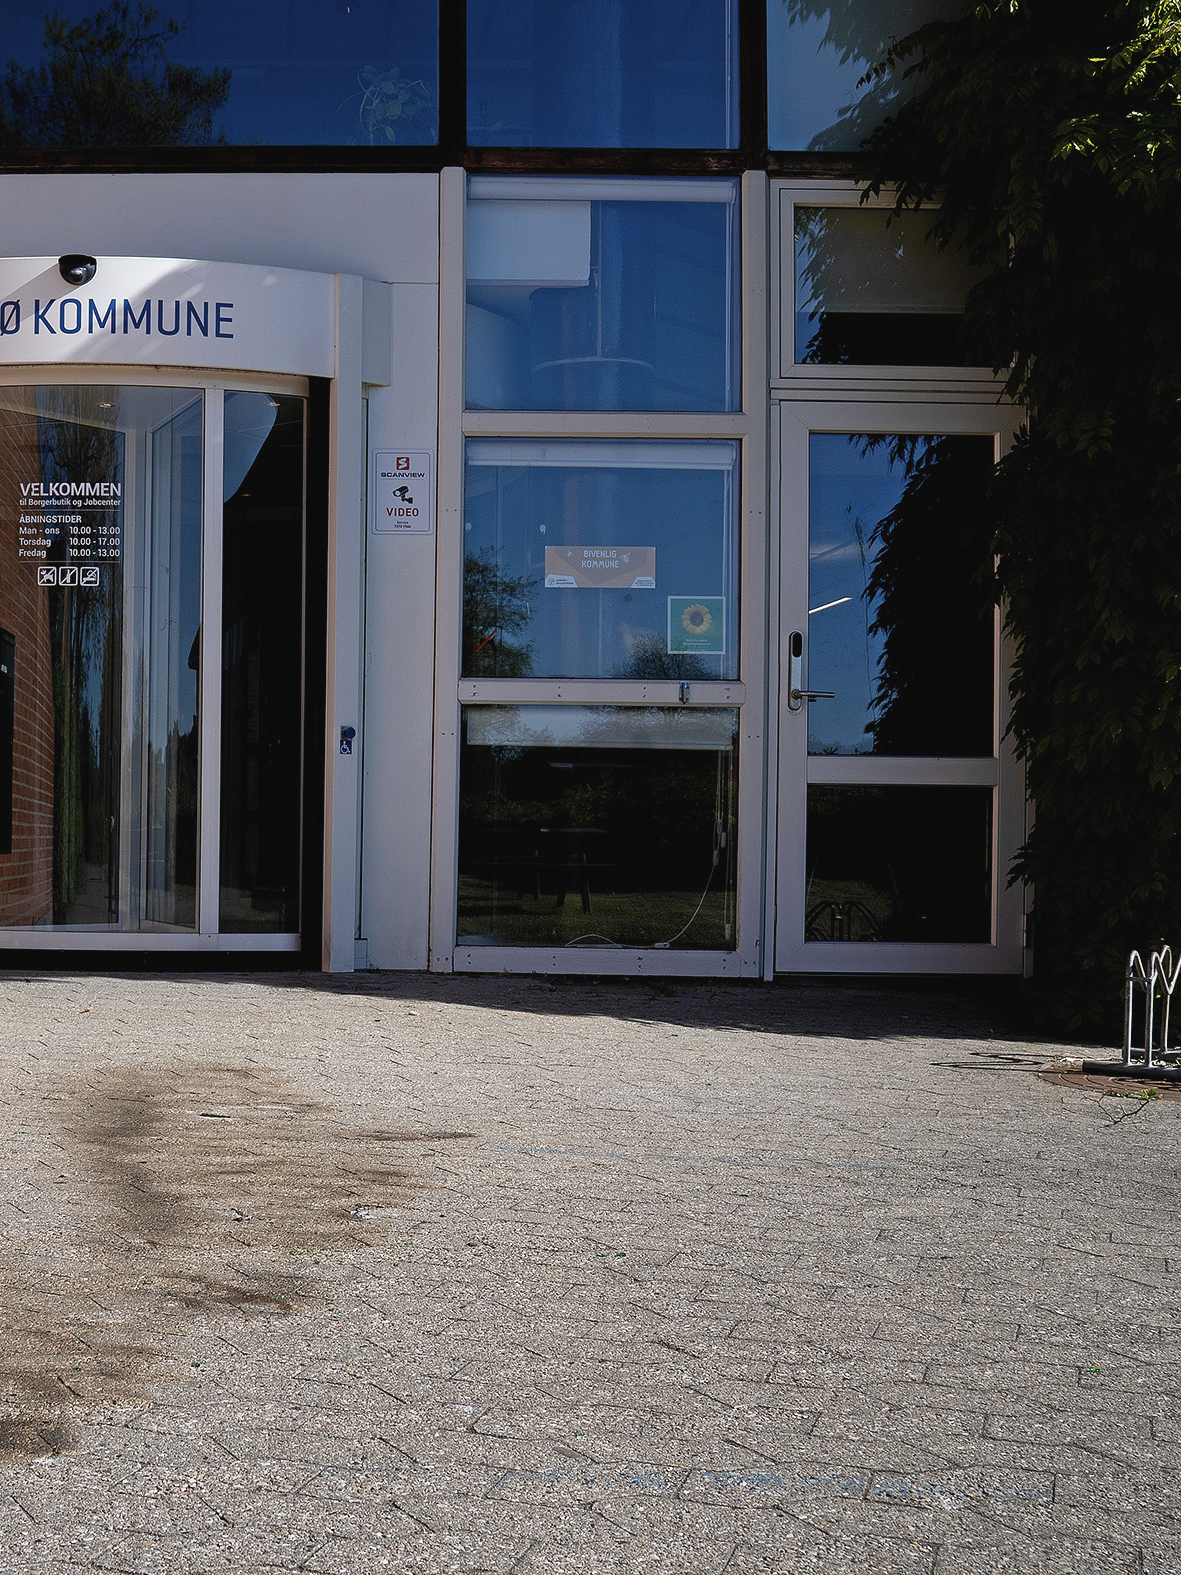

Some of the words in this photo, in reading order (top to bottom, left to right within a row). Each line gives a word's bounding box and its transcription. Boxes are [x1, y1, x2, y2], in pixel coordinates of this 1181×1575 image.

[33, 298, 234, 339] KOMMUNE
[19, 482, 122, 497] VELKOMMEN
[19, 498, 27, 506] til
[28, 498, 71, 508] Borgerbutik
[72, 500, 82, 508] og
[83, 498, 121, 506] Jobcenter
[386, 507, 420, 517] VIDEO
[19, 514, 82, 524] ÅBNINGSTIDER
[19, 527, 37, 535] Man
[69, 526, 91, 535] 10.00
[98, 526, 121, 535] 13.00
[19, 537, 52, 547] Torsdag
[69, 537, 91, 546] 10.00
[98, 537, 121, 546] 17.00
[18, 548, 47, 558] Fredag
[69, 548, 91, 557] 10.00
[98, 548, 121, 557] 13.00
[583, 549, 617, 558] BIVENLIG
[581, 560, 619, 569] KOMMUNE
